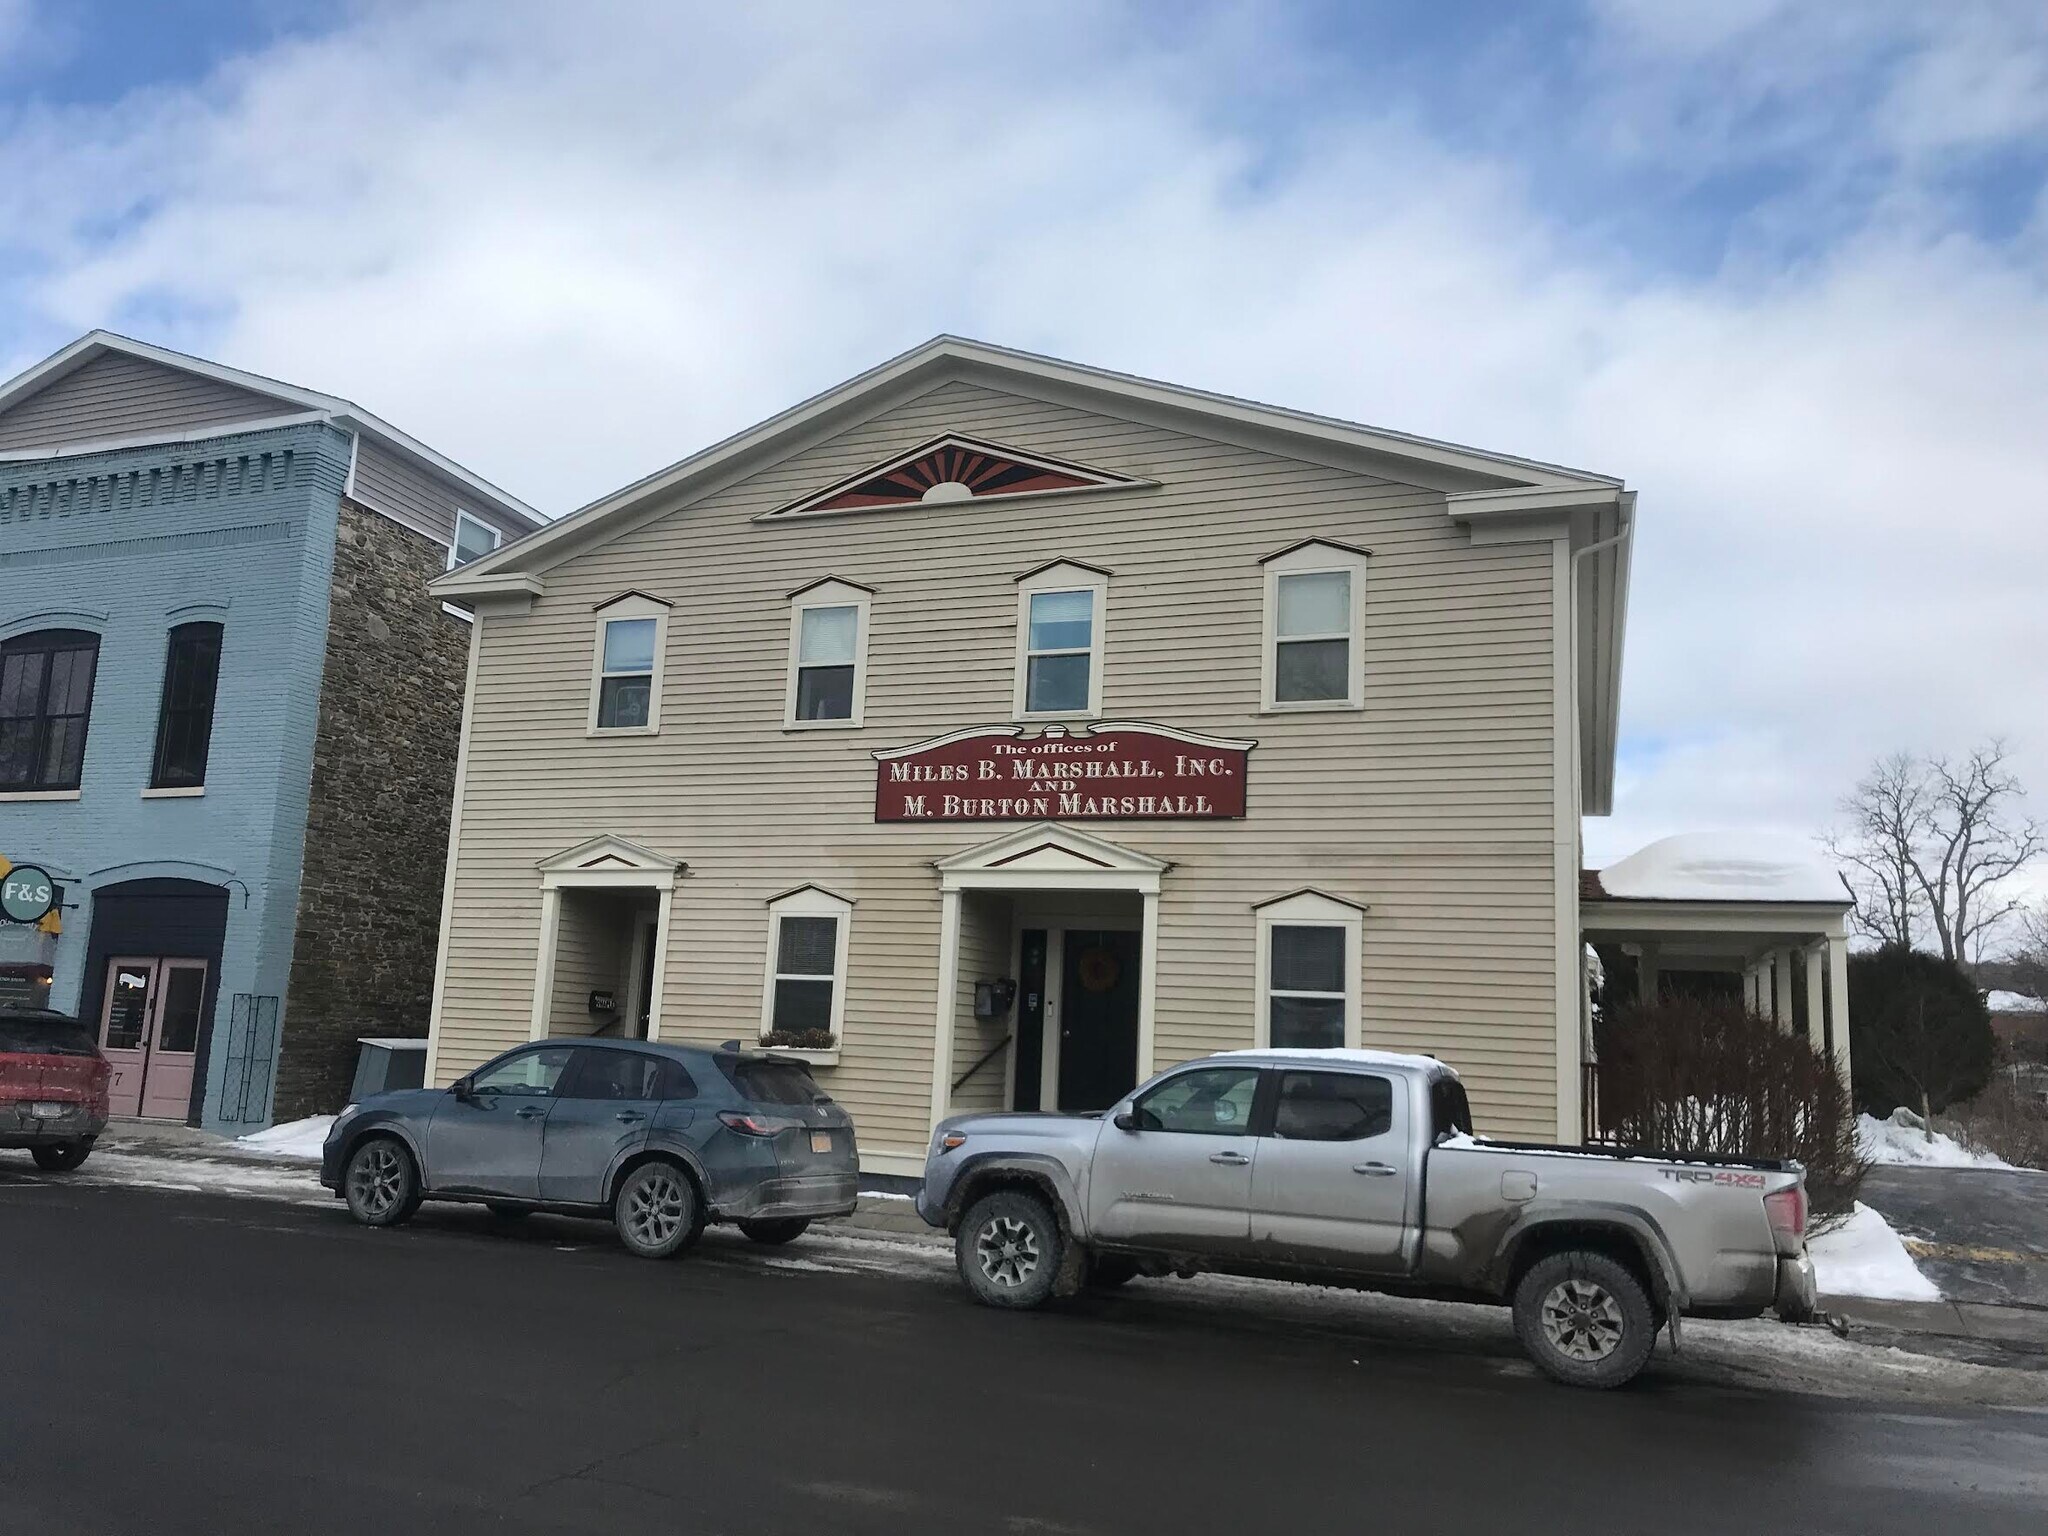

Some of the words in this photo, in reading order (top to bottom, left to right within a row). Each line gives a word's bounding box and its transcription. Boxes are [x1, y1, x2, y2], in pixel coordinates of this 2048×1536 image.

[991, 744, 1027, 755] The
[1031, 743, 1092, 754] offices
[1096, 741, 1118, 753] of
[889, 761, 969, 782] MILES
[977, 759, 1003, 780] B.
[1028, 780, 1077, 792] AND
[902, 795, 934, 817] M.
[942, 794, 1049, 817] BURTON
[1057, 793, 1213, 816] MARSHALL
[5, 882, 50, 903] F&S
[114, 1072, 124, 1087] 7
